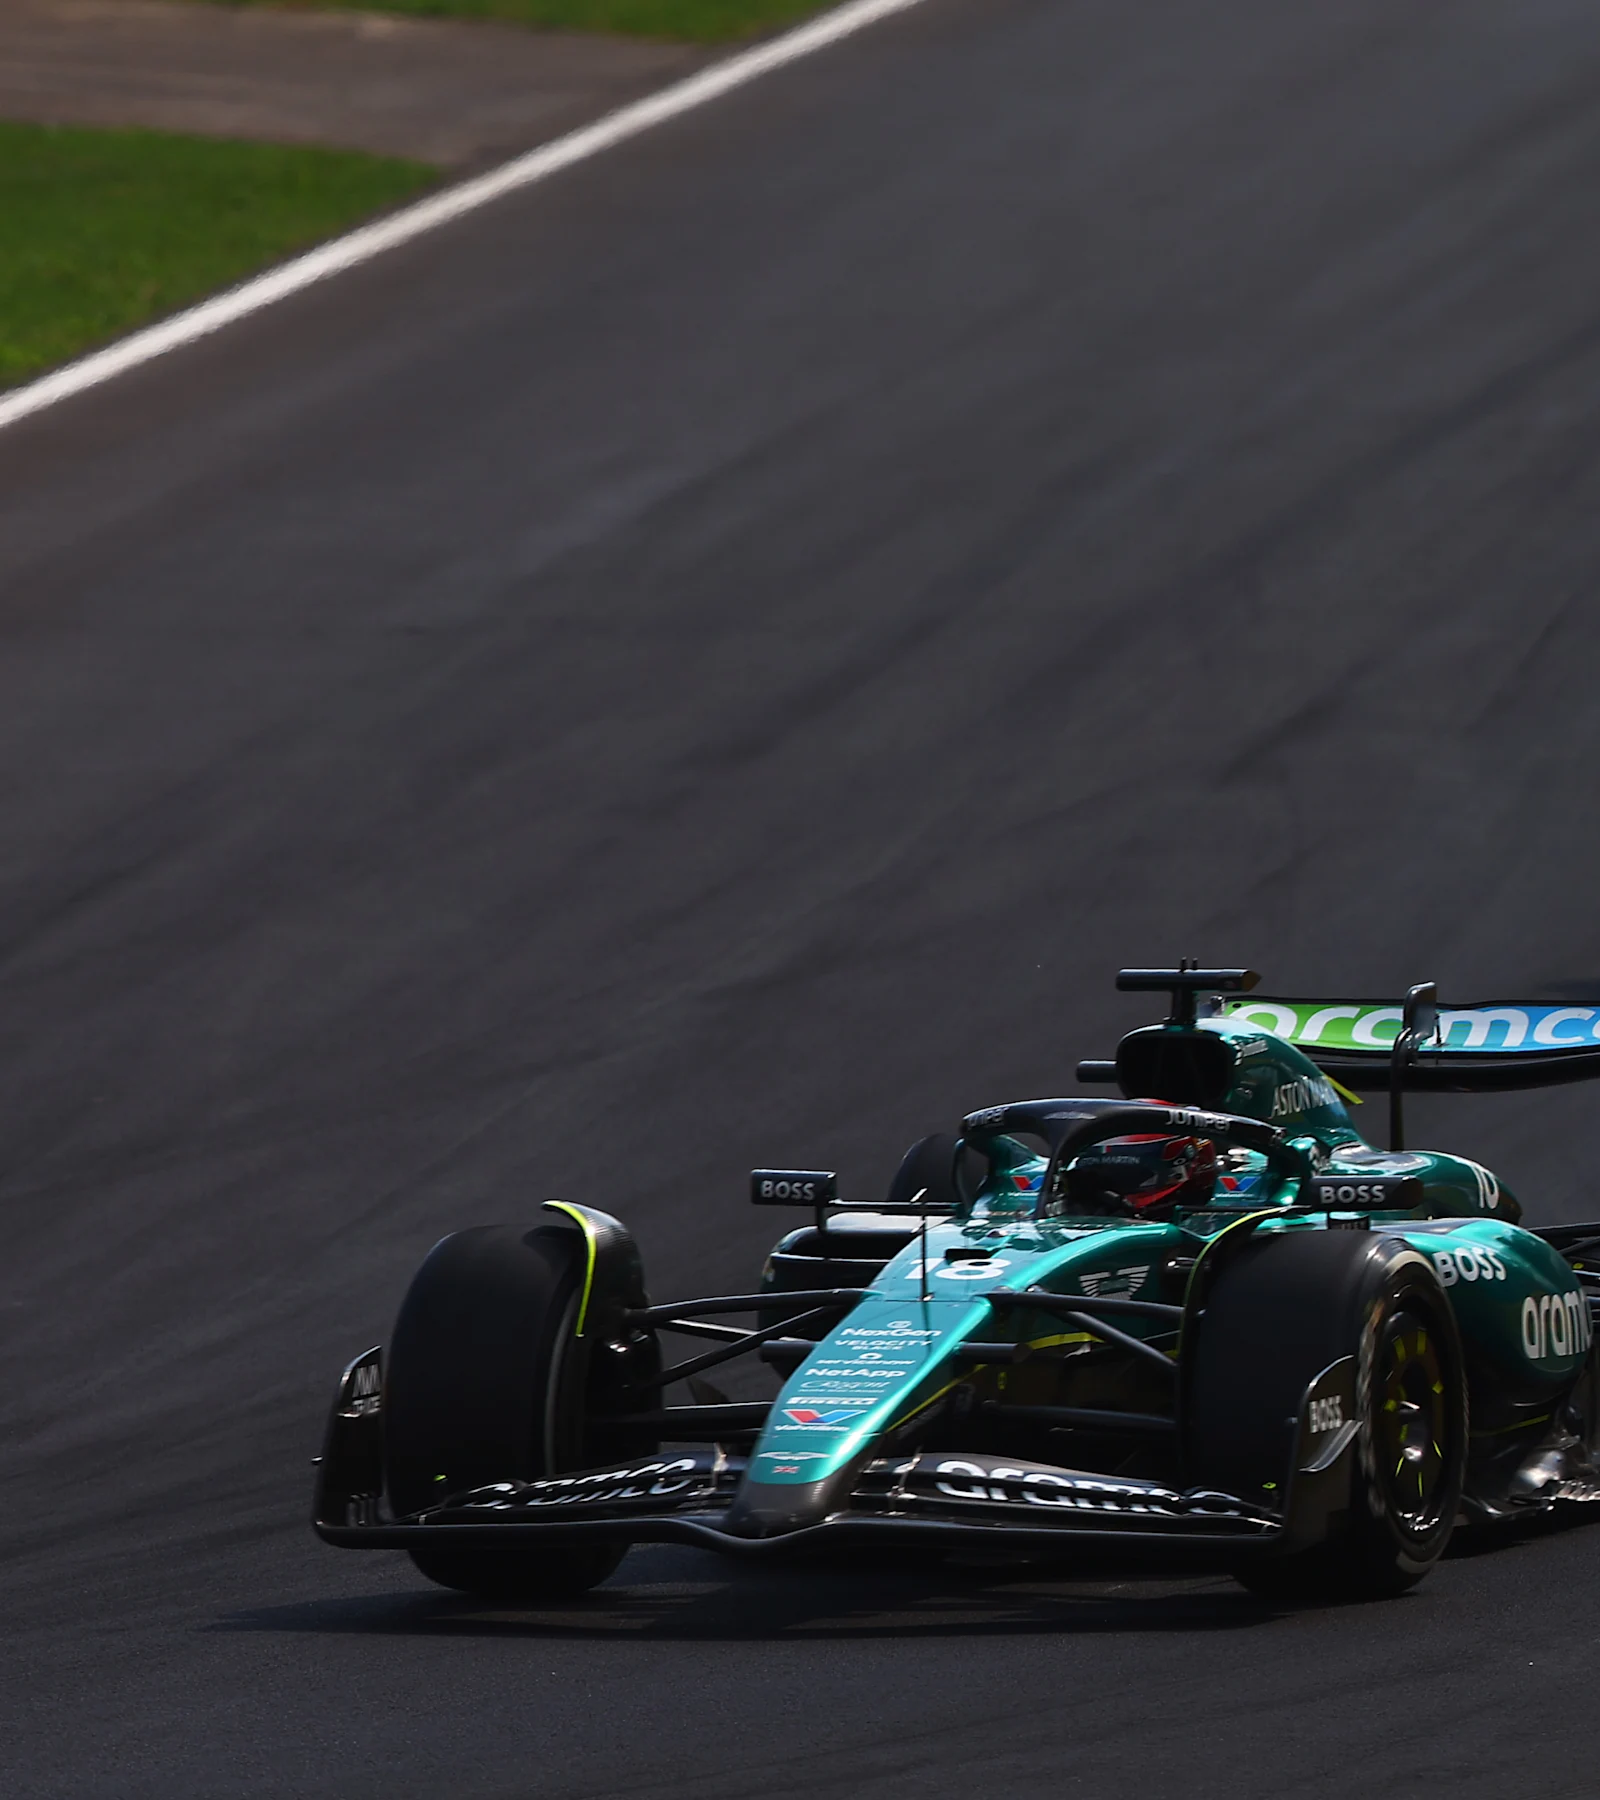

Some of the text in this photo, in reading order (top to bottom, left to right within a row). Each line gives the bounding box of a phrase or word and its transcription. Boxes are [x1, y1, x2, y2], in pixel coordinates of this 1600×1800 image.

[760, 1179, 816, 1201] BOSS
[1319, 1184, 1386, 1204] BOSS
[904, 1257, 1012, 1281] 18
[1433, 1246, 1507, 1288] BOSS
[840, 1327, 943, 1337] NexGen
[804, 1368, 907, 1378] NetApp
[1308, 1394, 1343, 1434] BOSS
